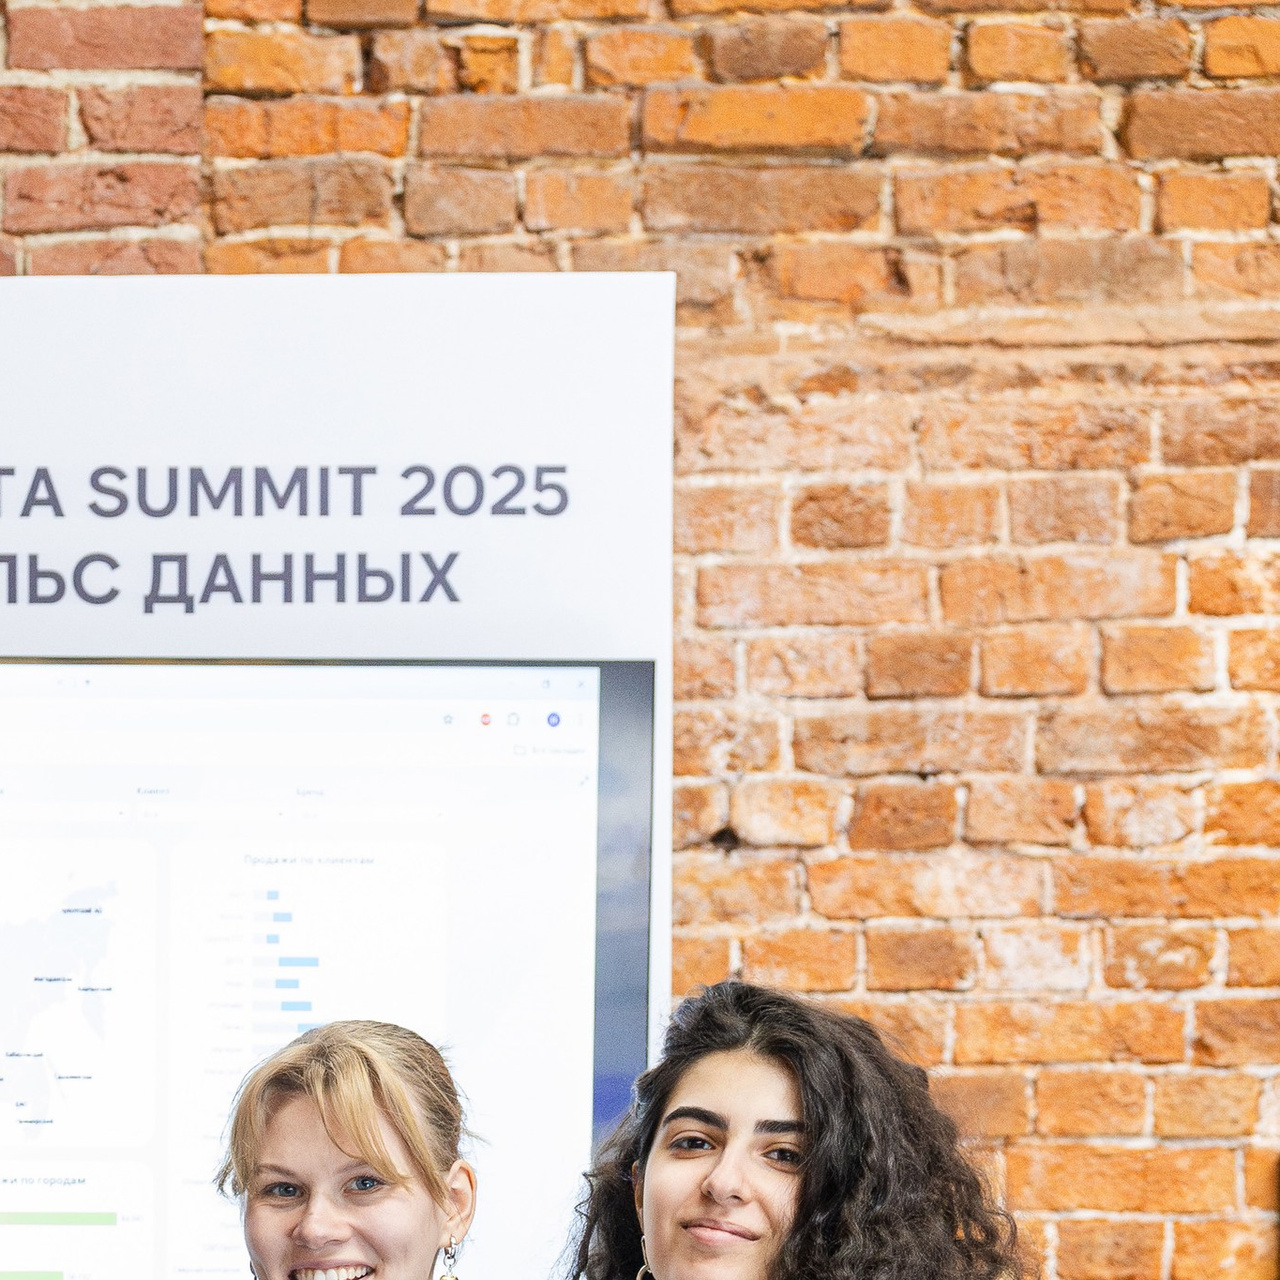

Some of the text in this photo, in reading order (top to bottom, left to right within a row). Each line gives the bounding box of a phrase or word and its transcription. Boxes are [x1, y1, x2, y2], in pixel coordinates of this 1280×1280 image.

[88, 466, 377, 518] SUMMIT
[401, 465, 568, 516] 2025
[143, 552, 460, 614] ДАННЫХ
